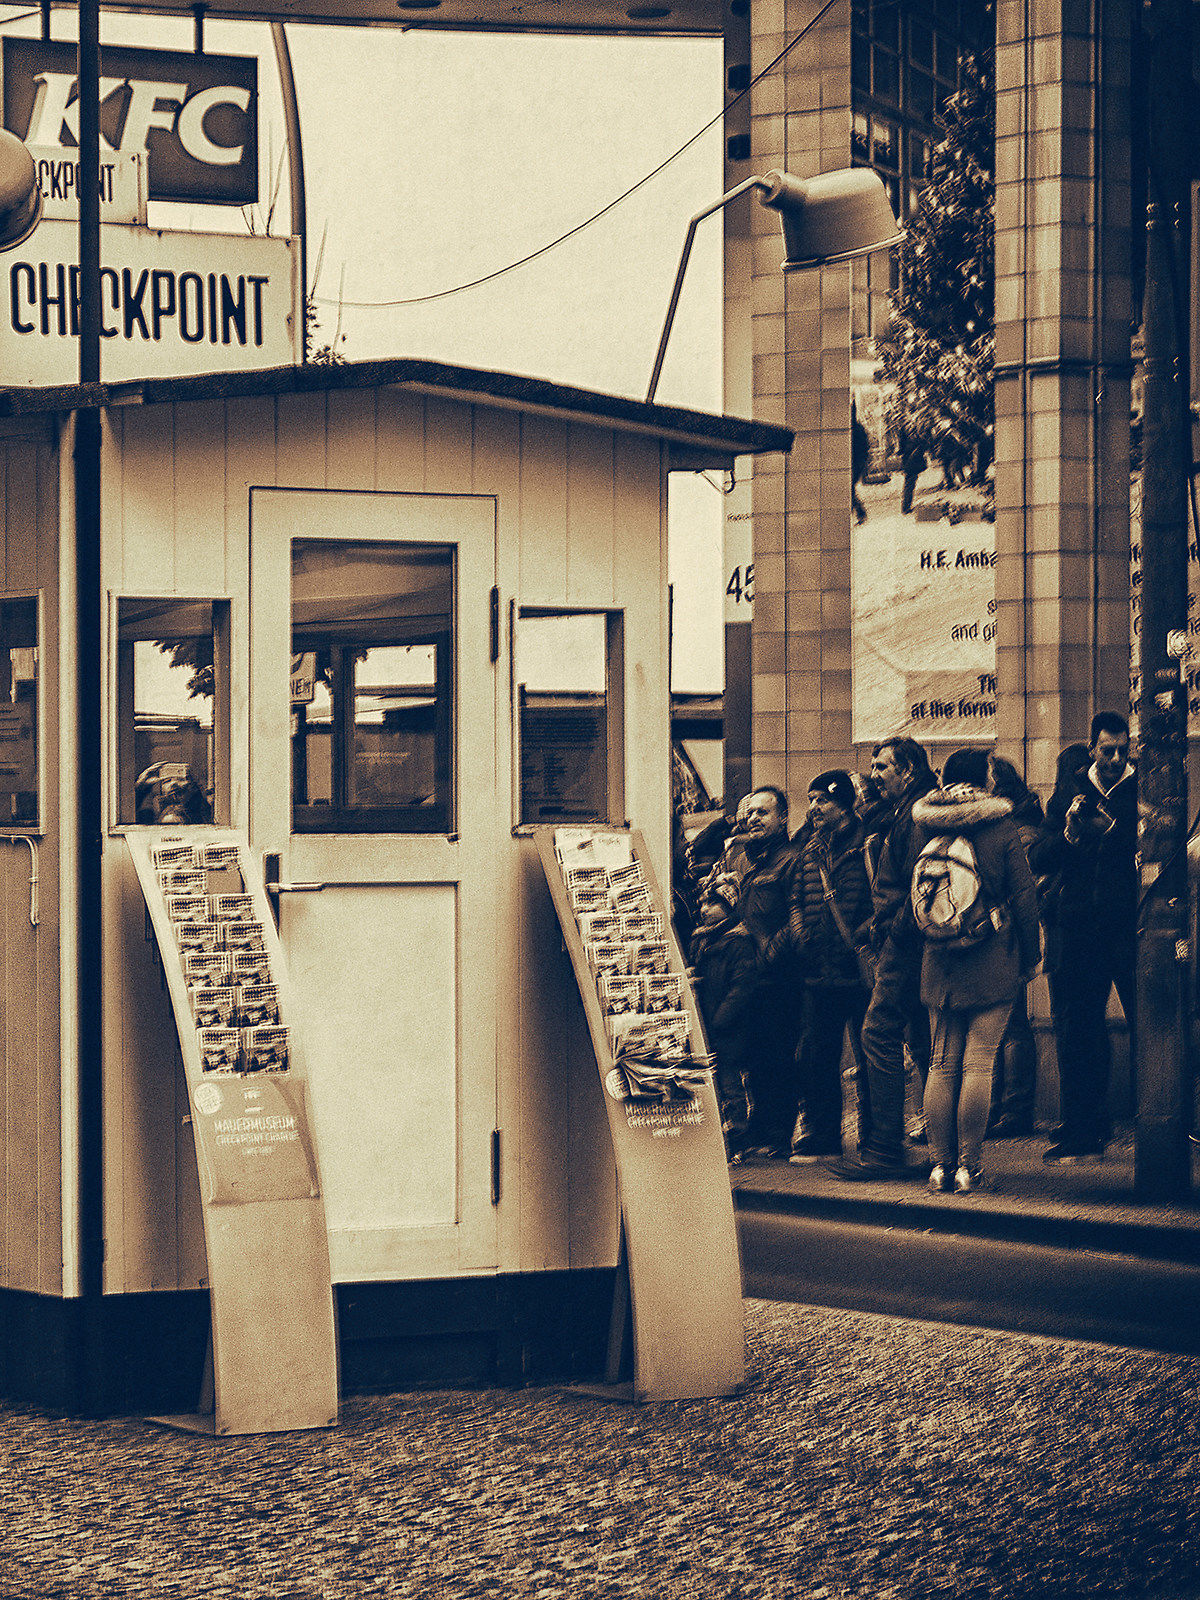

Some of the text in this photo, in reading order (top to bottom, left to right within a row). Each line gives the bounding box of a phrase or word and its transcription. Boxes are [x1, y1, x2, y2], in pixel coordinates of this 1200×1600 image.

[26, 72, 251, 166] KFC
[10, 261, 270, 347] CHECKPOINT
[951, 622, 978, 640] and
